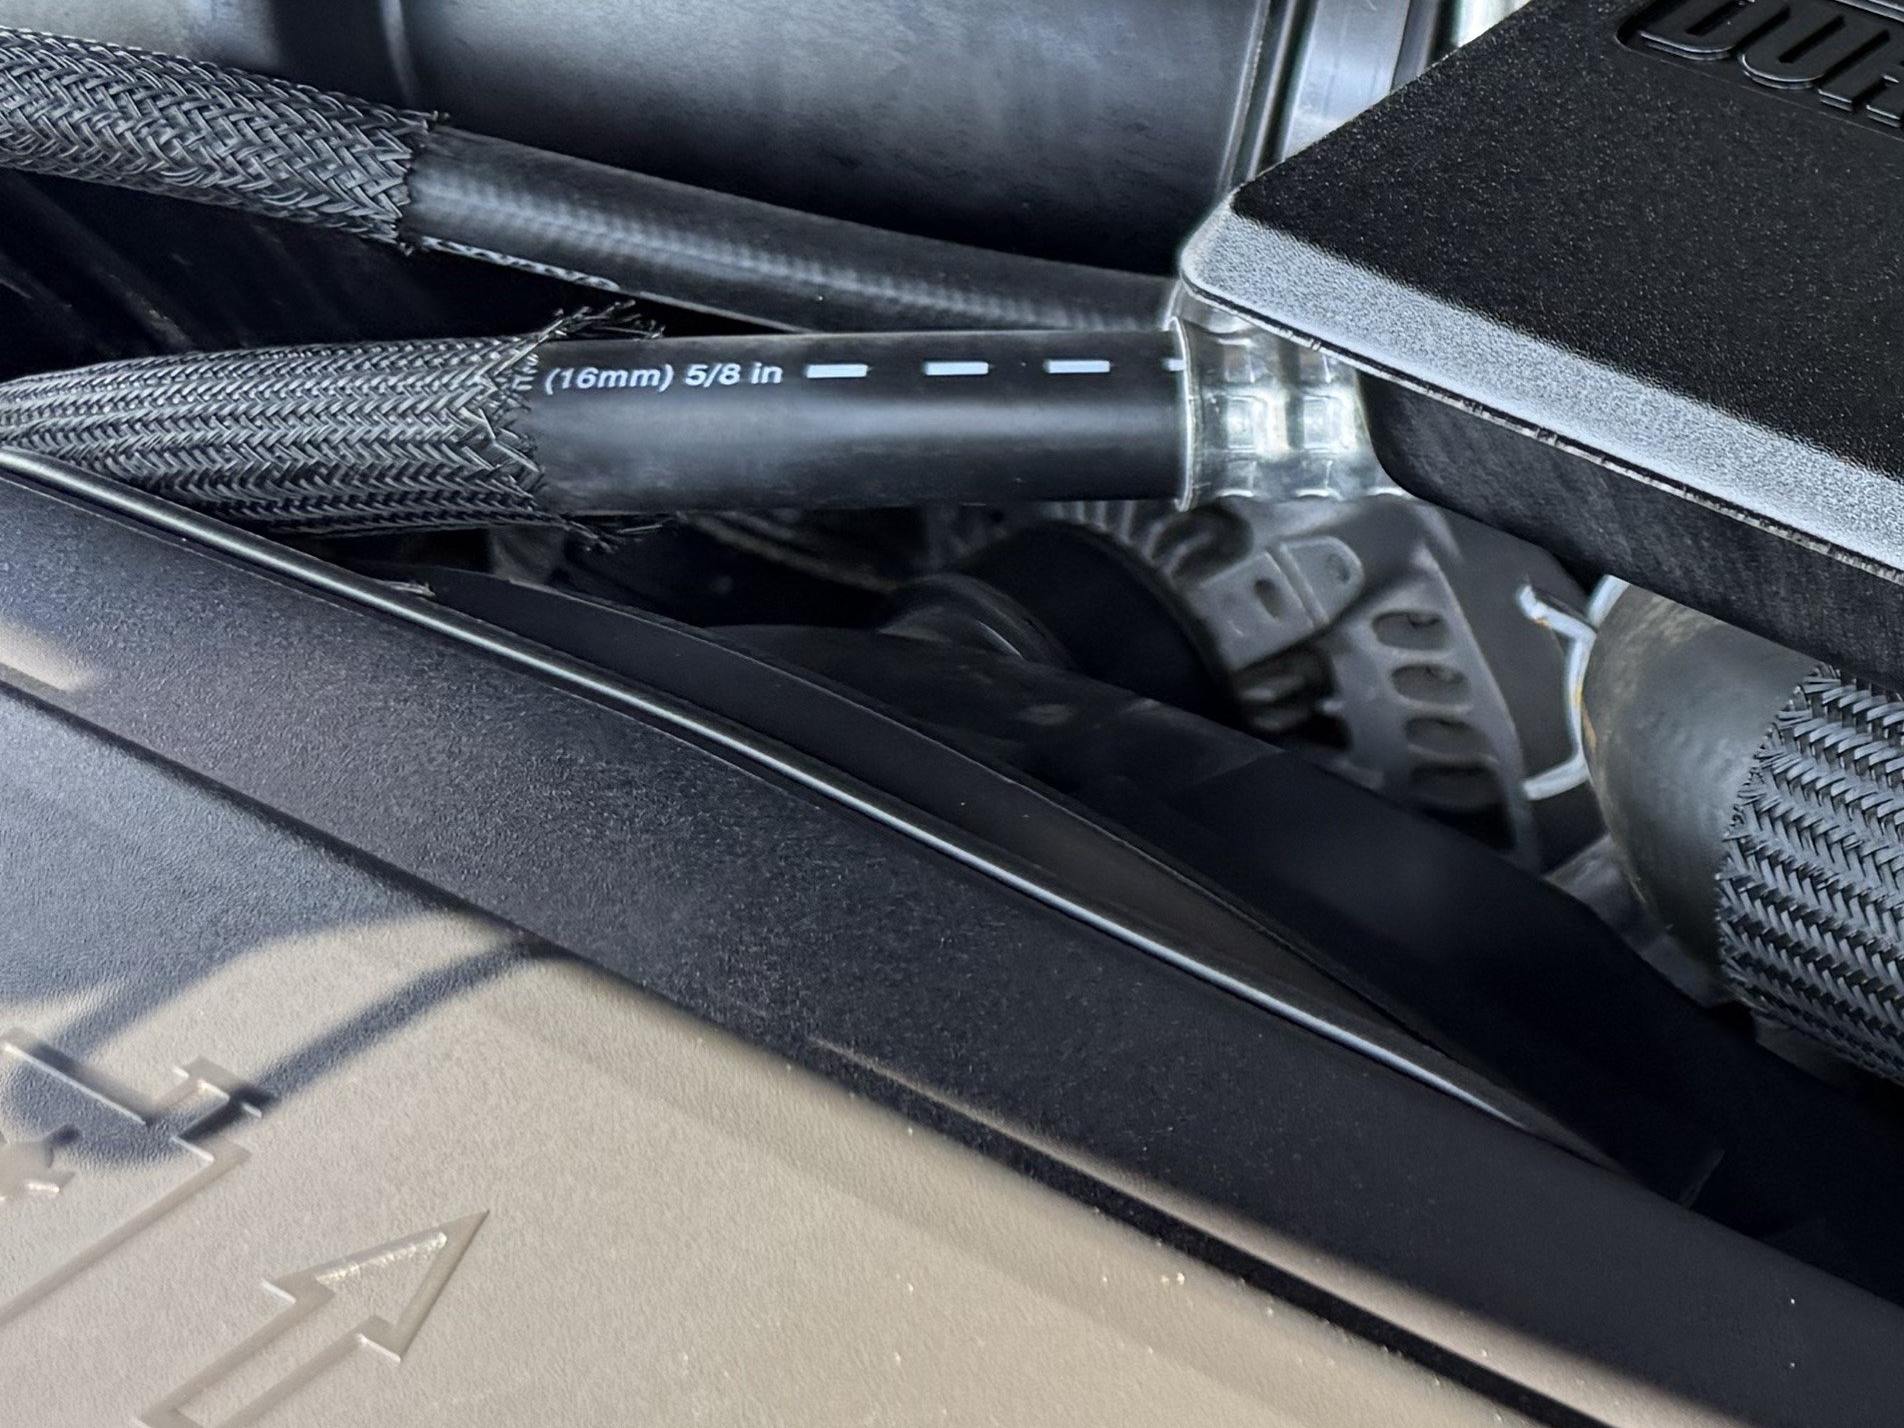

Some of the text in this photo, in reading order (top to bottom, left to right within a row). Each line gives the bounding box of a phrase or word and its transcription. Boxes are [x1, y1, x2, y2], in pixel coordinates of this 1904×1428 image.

[545, 364, 674, 395] (16mm)
[684, 362, 742, 388] 5/8
[750, 361, 784, 385] in
